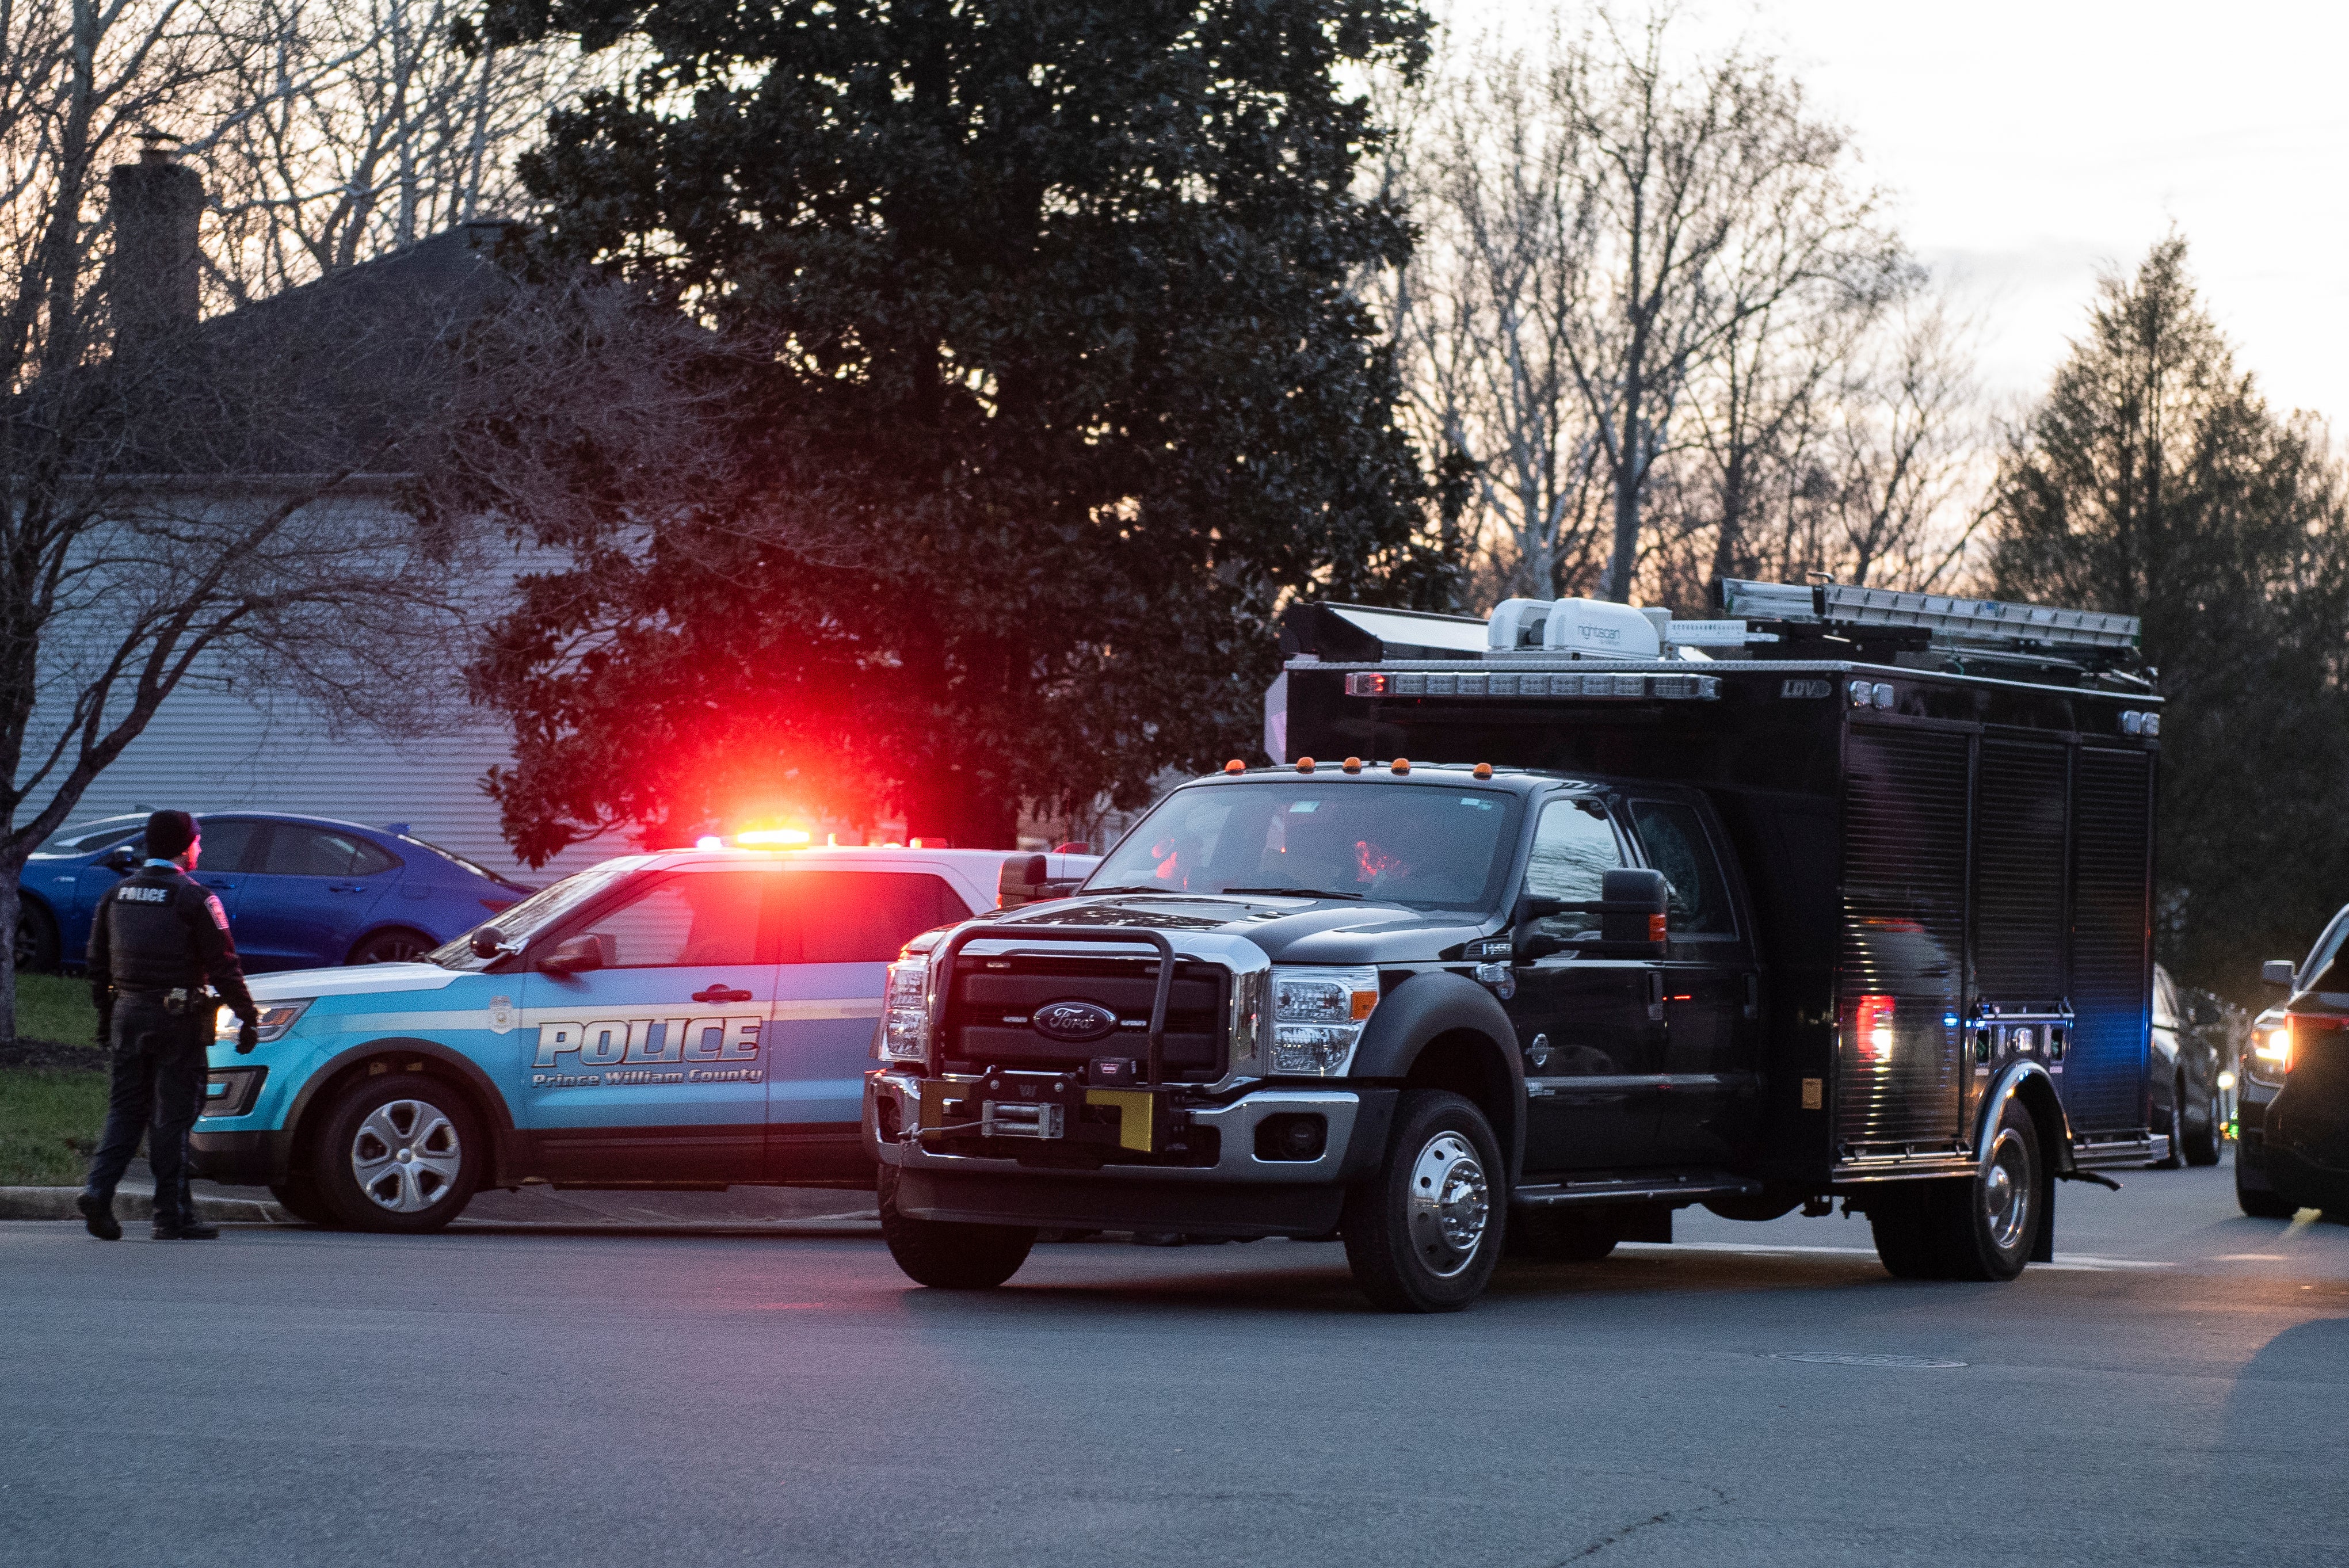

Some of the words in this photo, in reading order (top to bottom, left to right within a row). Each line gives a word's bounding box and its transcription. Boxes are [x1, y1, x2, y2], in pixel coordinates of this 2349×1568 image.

[117, 887, 167, 902] POLICE
[1049, 1008, 1094, 1029] Ford
[531, 1016, 762, 1069] POLICE
[532, 1074, 601, 1088] Prince
[605, 1070, 684, 1086] William
[689, 1069, 764, 1084] County
